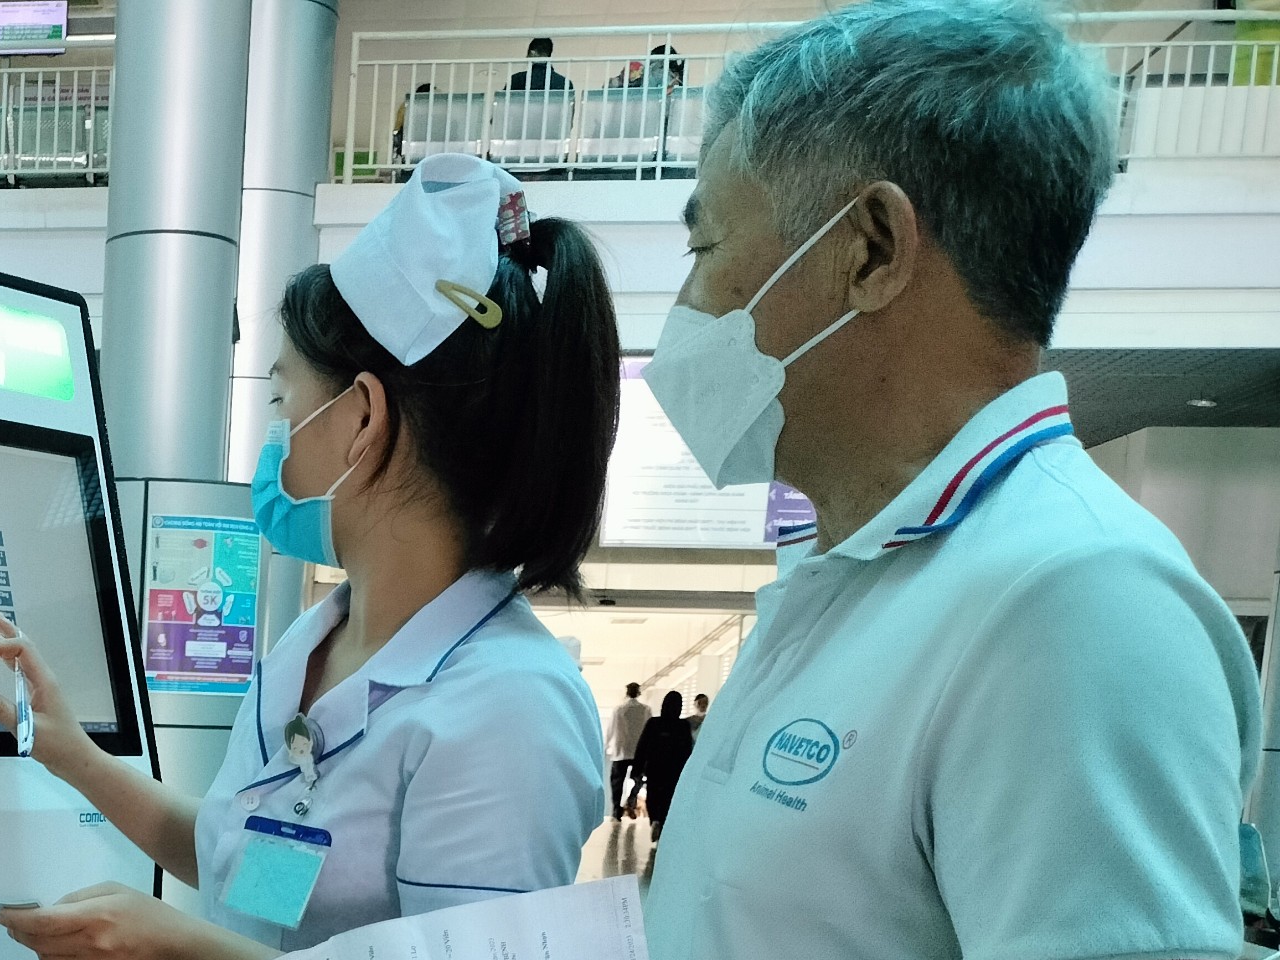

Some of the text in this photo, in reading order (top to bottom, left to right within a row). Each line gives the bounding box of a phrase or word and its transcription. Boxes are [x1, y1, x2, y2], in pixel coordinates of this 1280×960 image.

[203, 596, 217, 605] 5K
[774, 731, 831, 764] NAVETCO
[750, 781, 808, 812] Animal Health
